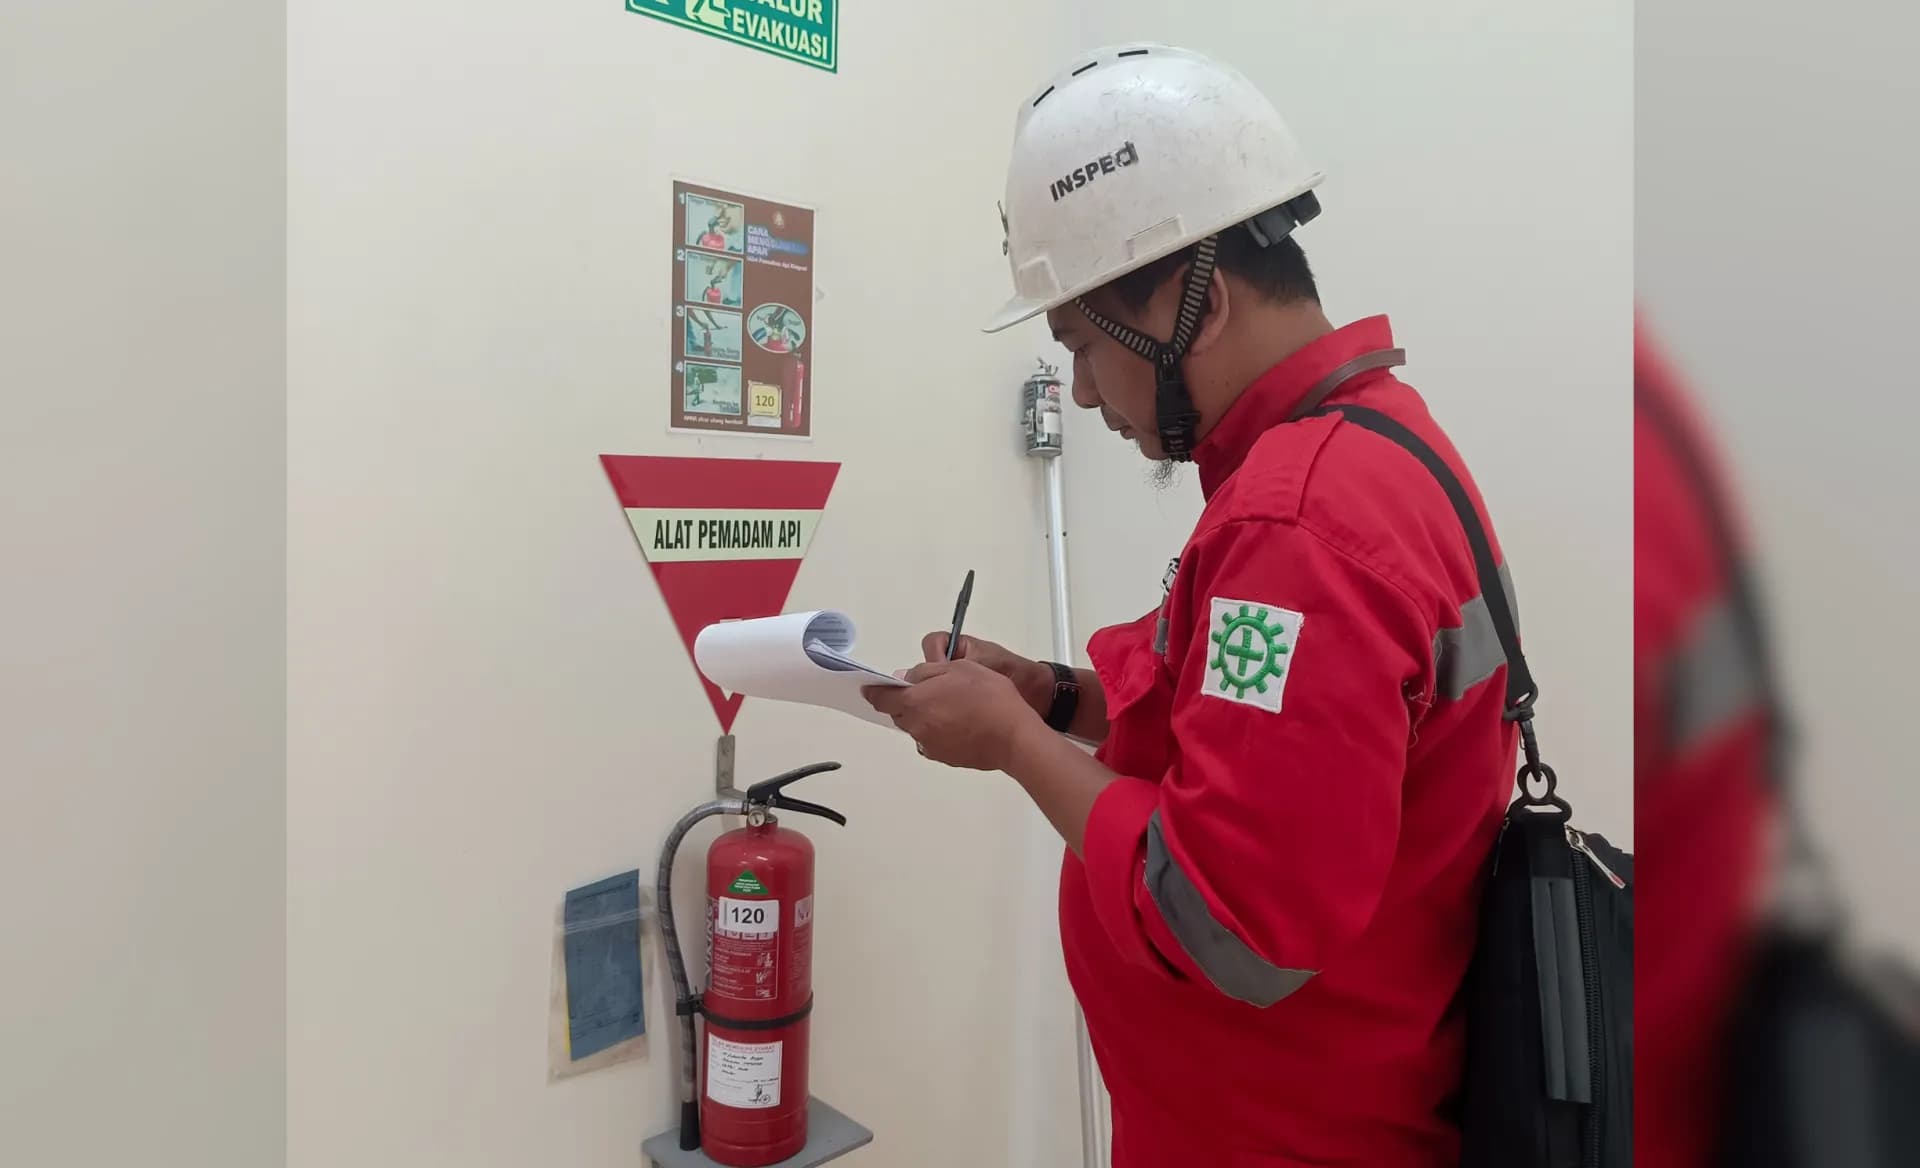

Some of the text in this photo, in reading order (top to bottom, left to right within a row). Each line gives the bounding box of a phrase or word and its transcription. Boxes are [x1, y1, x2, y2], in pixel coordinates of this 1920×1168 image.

[732, 8, 828, 60] EVAKUASI
[679, 193, 685, 205] 1
[677, 250, 685, 262] 2
[676, 305, 684, 317] 3
[675, 361, 684, 373] 4
[755, 395, 775, 407] 120
[654, 519, 801, 549] ALAT PEMADAM API
[731, 906, 765, 924] 120
